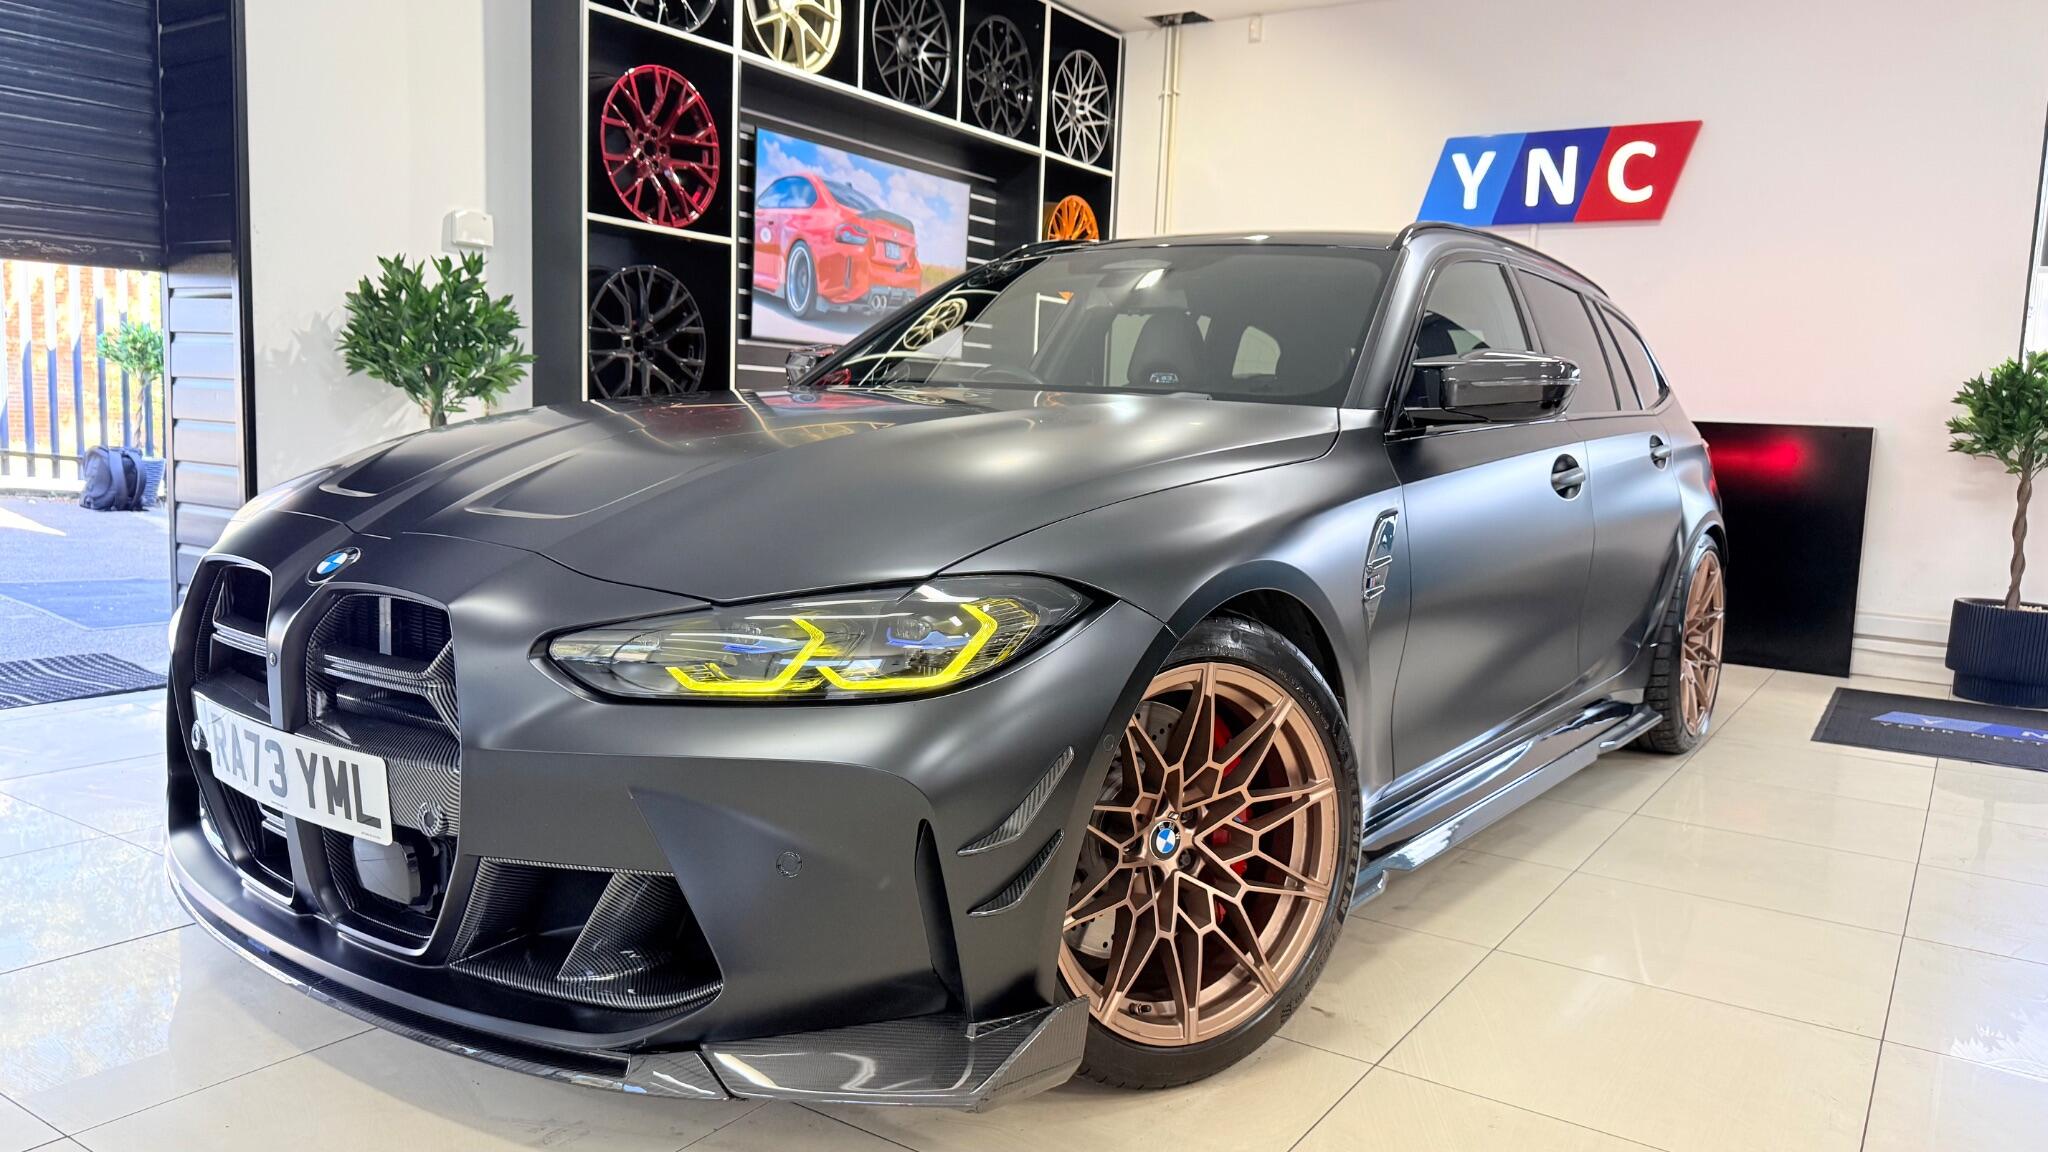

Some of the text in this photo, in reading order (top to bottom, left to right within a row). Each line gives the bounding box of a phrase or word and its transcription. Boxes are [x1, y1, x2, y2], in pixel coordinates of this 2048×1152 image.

[1451, 140, 1657, 210] YNC
[210, 711, 382, 830] RA73 YML
